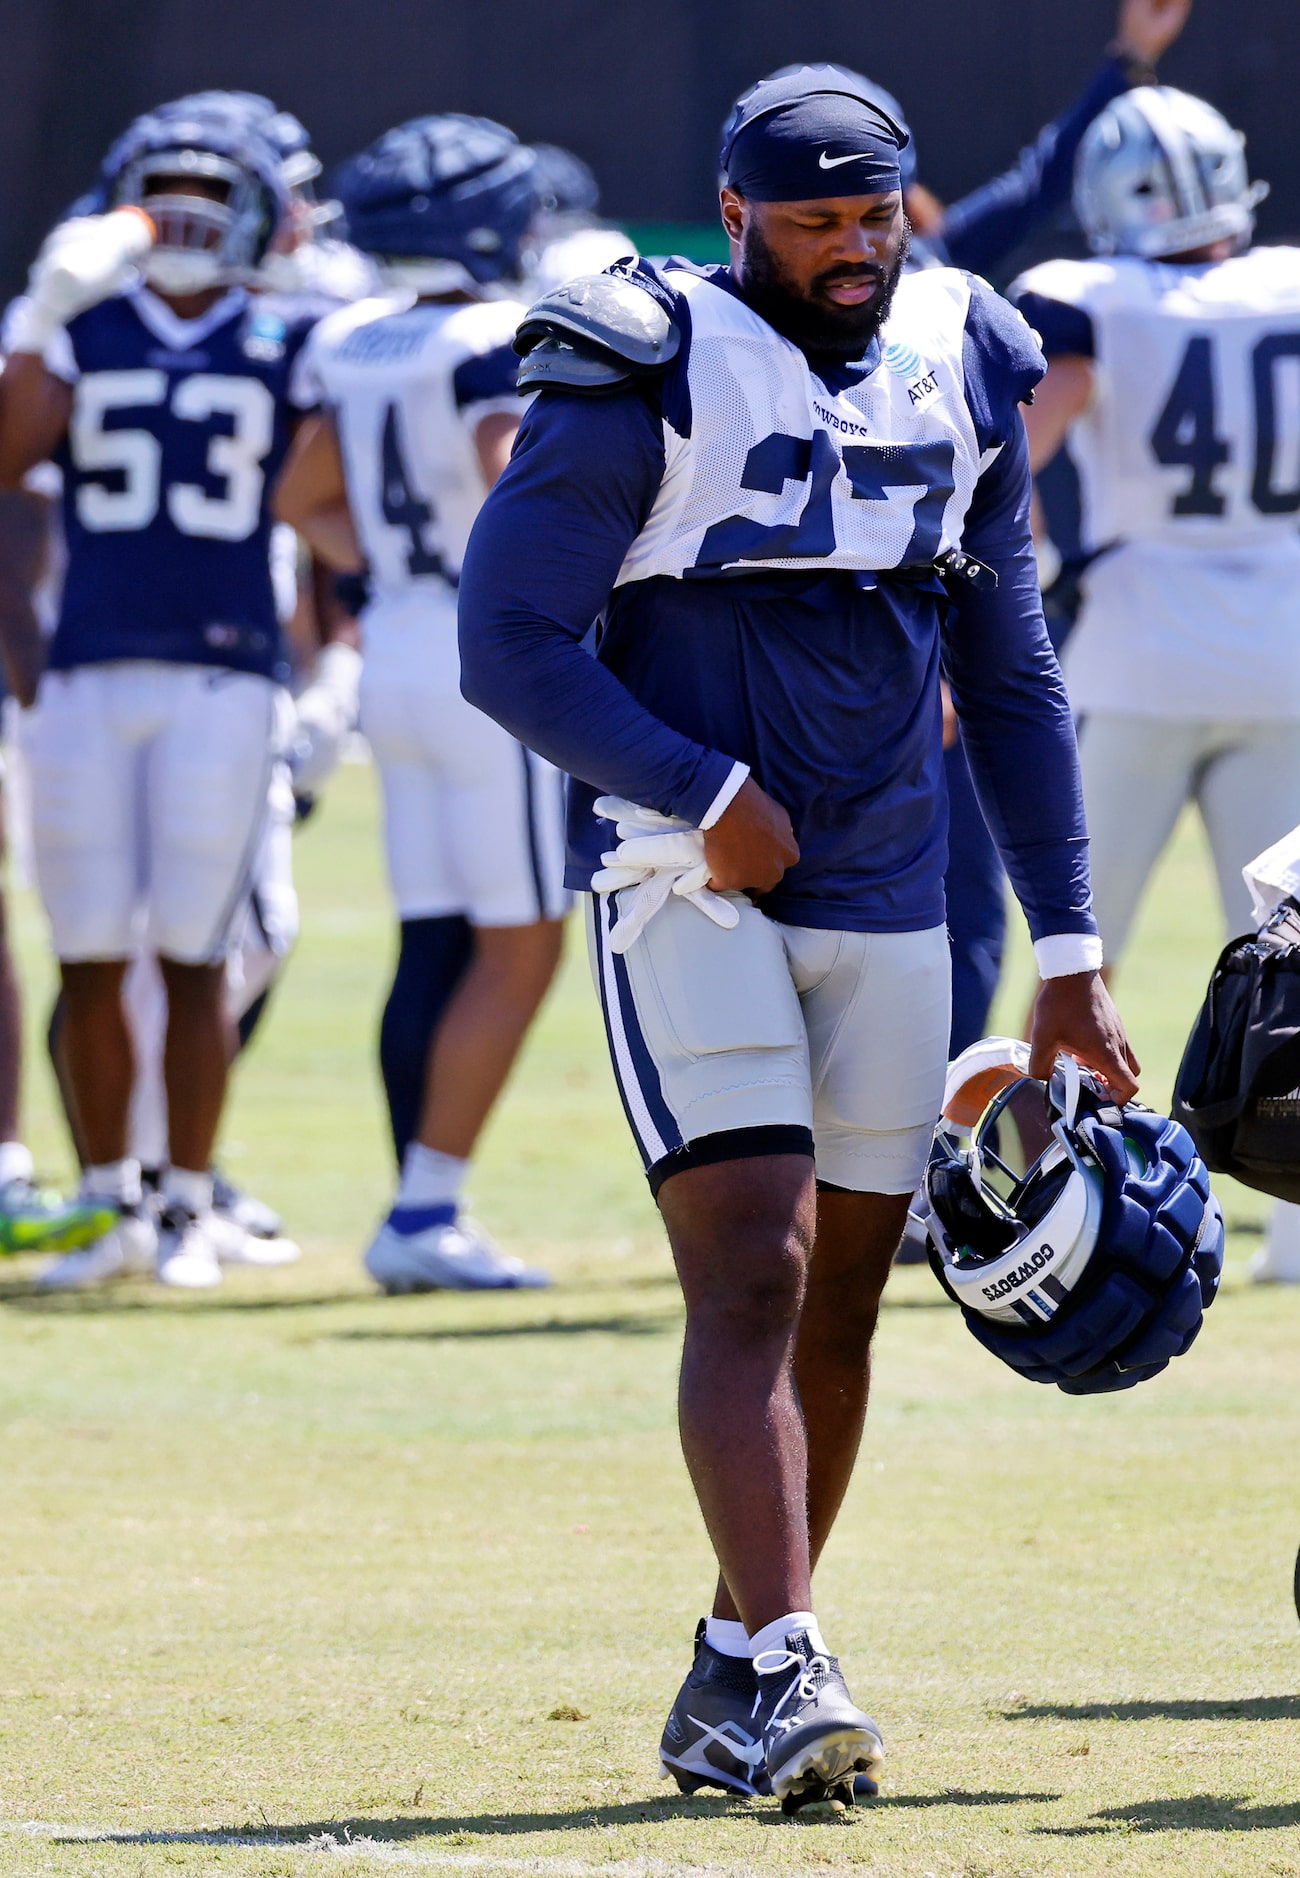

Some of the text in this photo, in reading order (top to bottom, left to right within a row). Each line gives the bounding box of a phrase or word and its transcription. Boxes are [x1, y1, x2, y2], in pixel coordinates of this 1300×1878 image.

[907, 370, 940, 406] AT&T
[812, 400, 868, 437] OWBOYS
[70, 369, 276, 543] 53
[686, 430, 956, 576] 27
[981, 1243, 1055, 1302] COWBOYS
